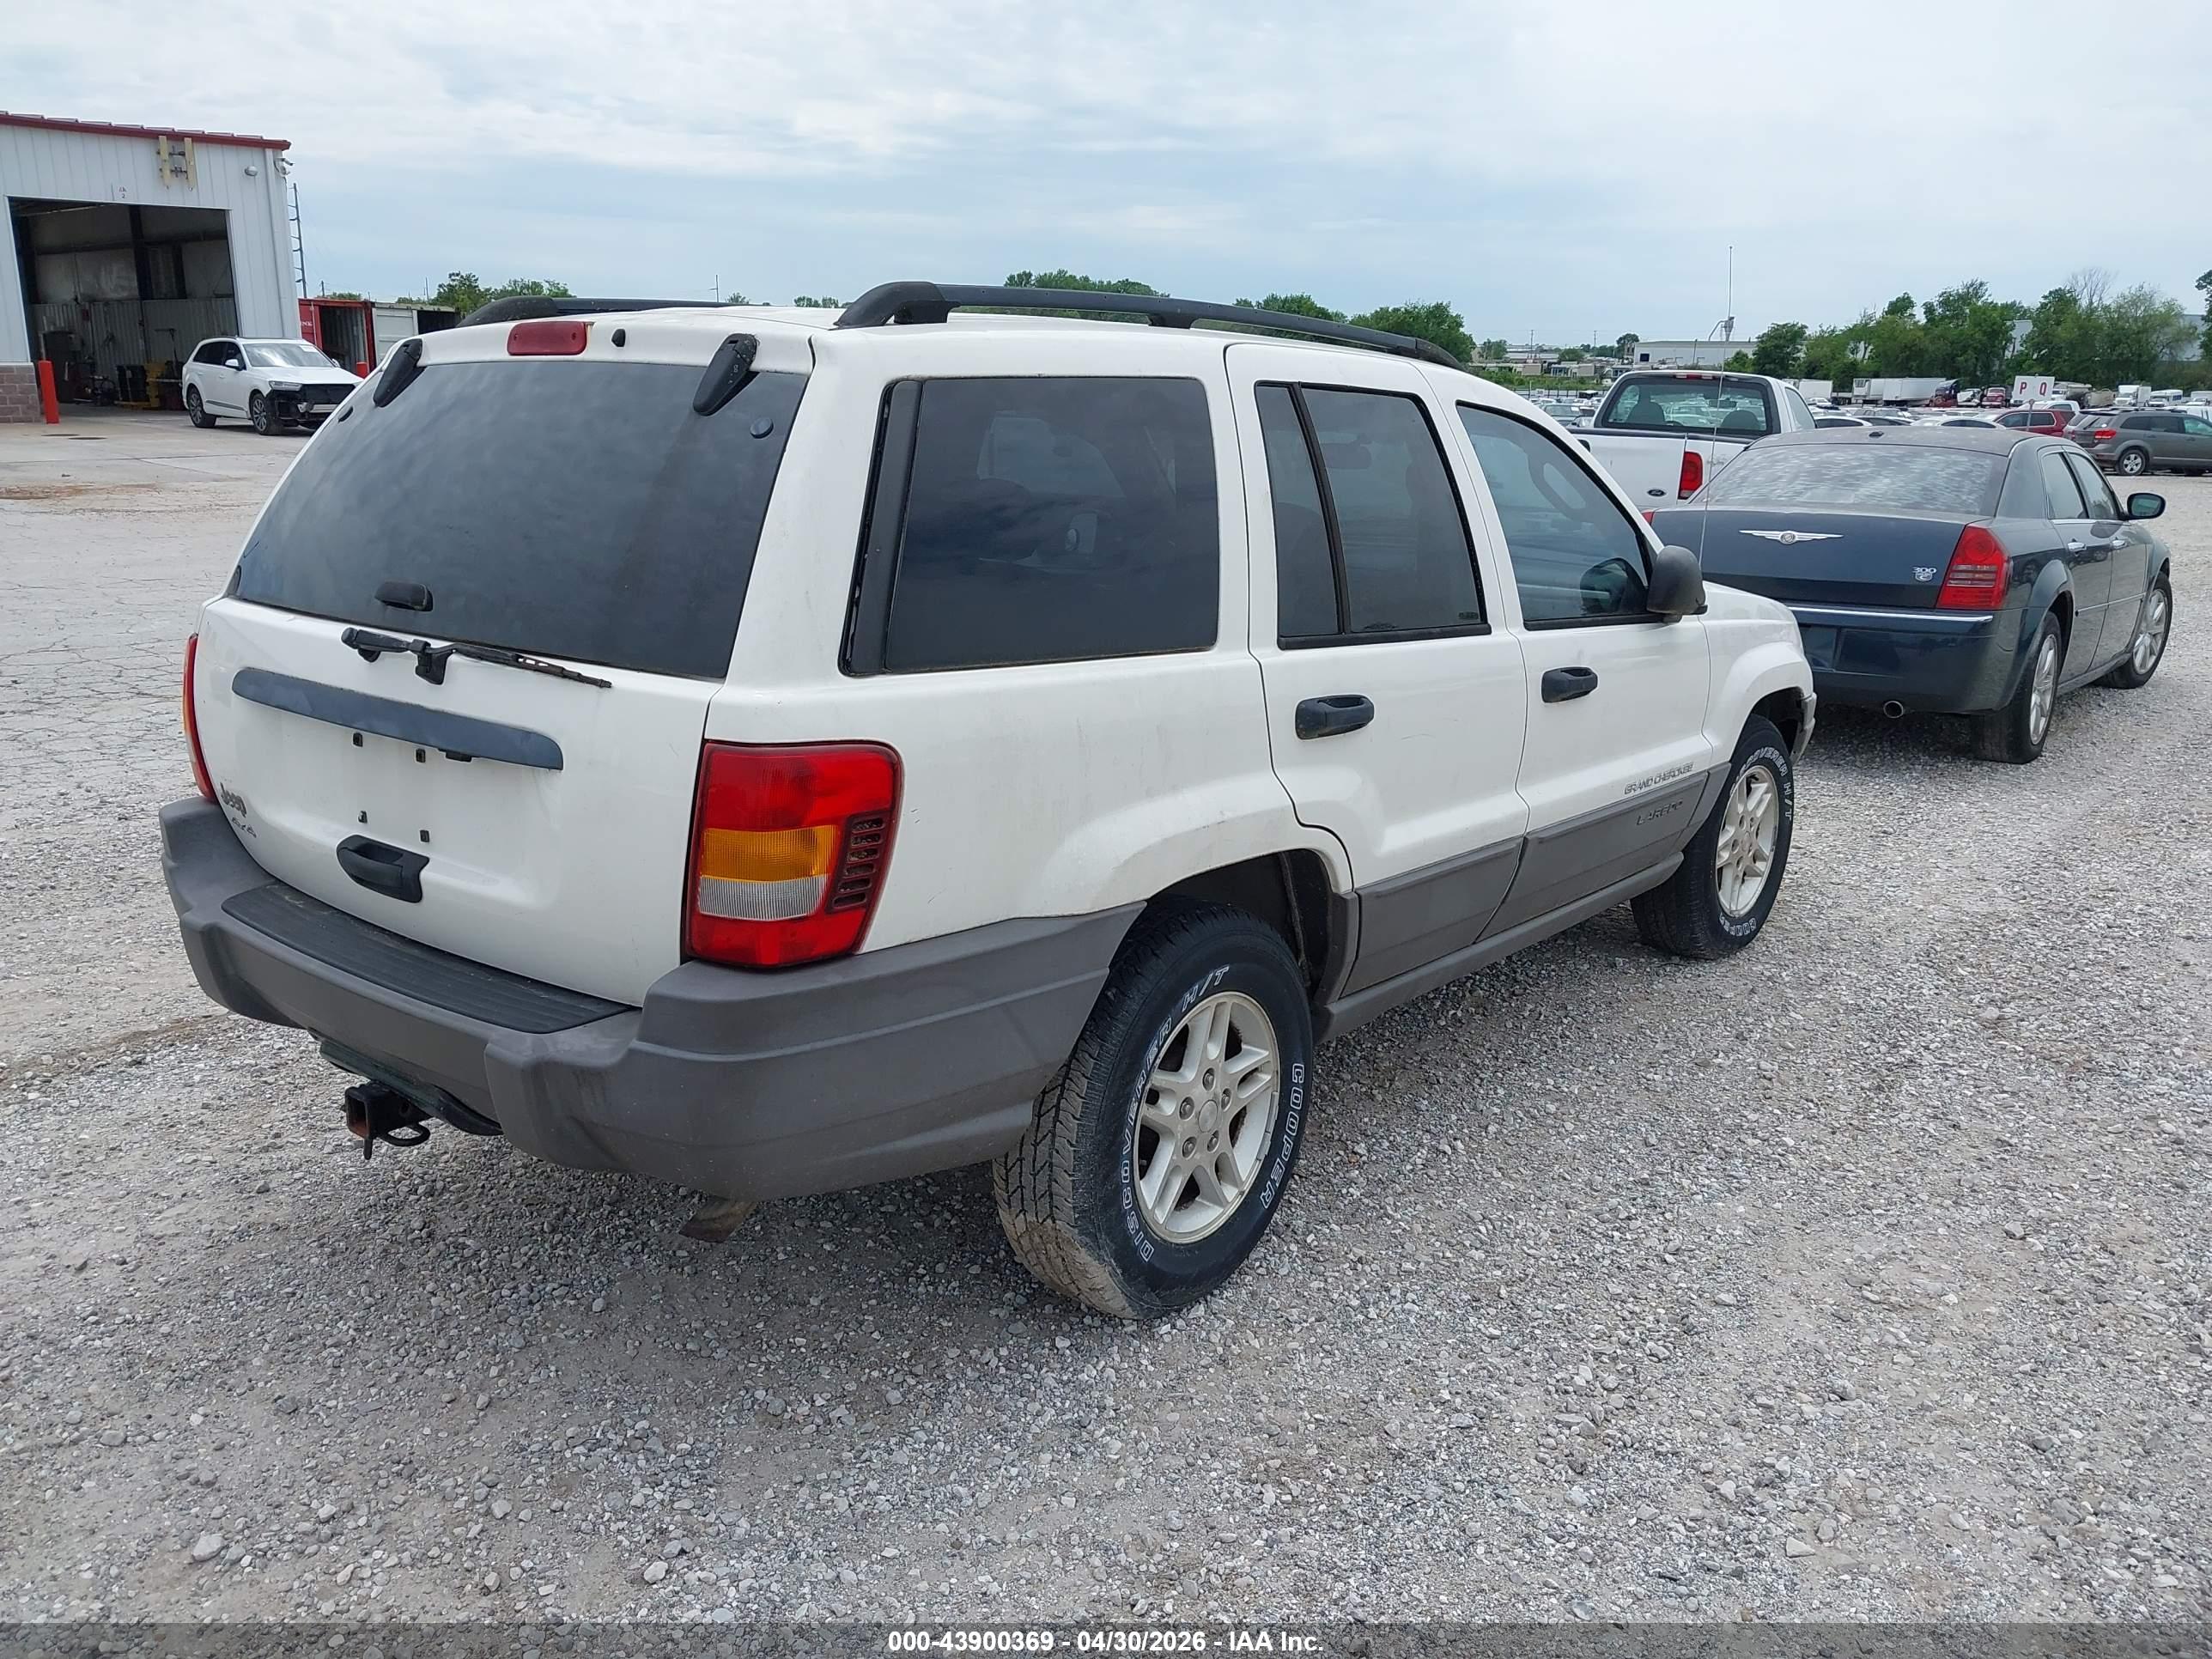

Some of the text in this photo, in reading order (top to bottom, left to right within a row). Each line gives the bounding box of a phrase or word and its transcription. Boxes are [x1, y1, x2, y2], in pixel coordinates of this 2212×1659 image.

[2019, 381, 2047, 396] P Q
[1624, 775, 1654, 795] GRAND
[1121, 965, 1231, 1263] DISCOVERER H/T
[1260, 1062, 1304, 1210] COOPER
